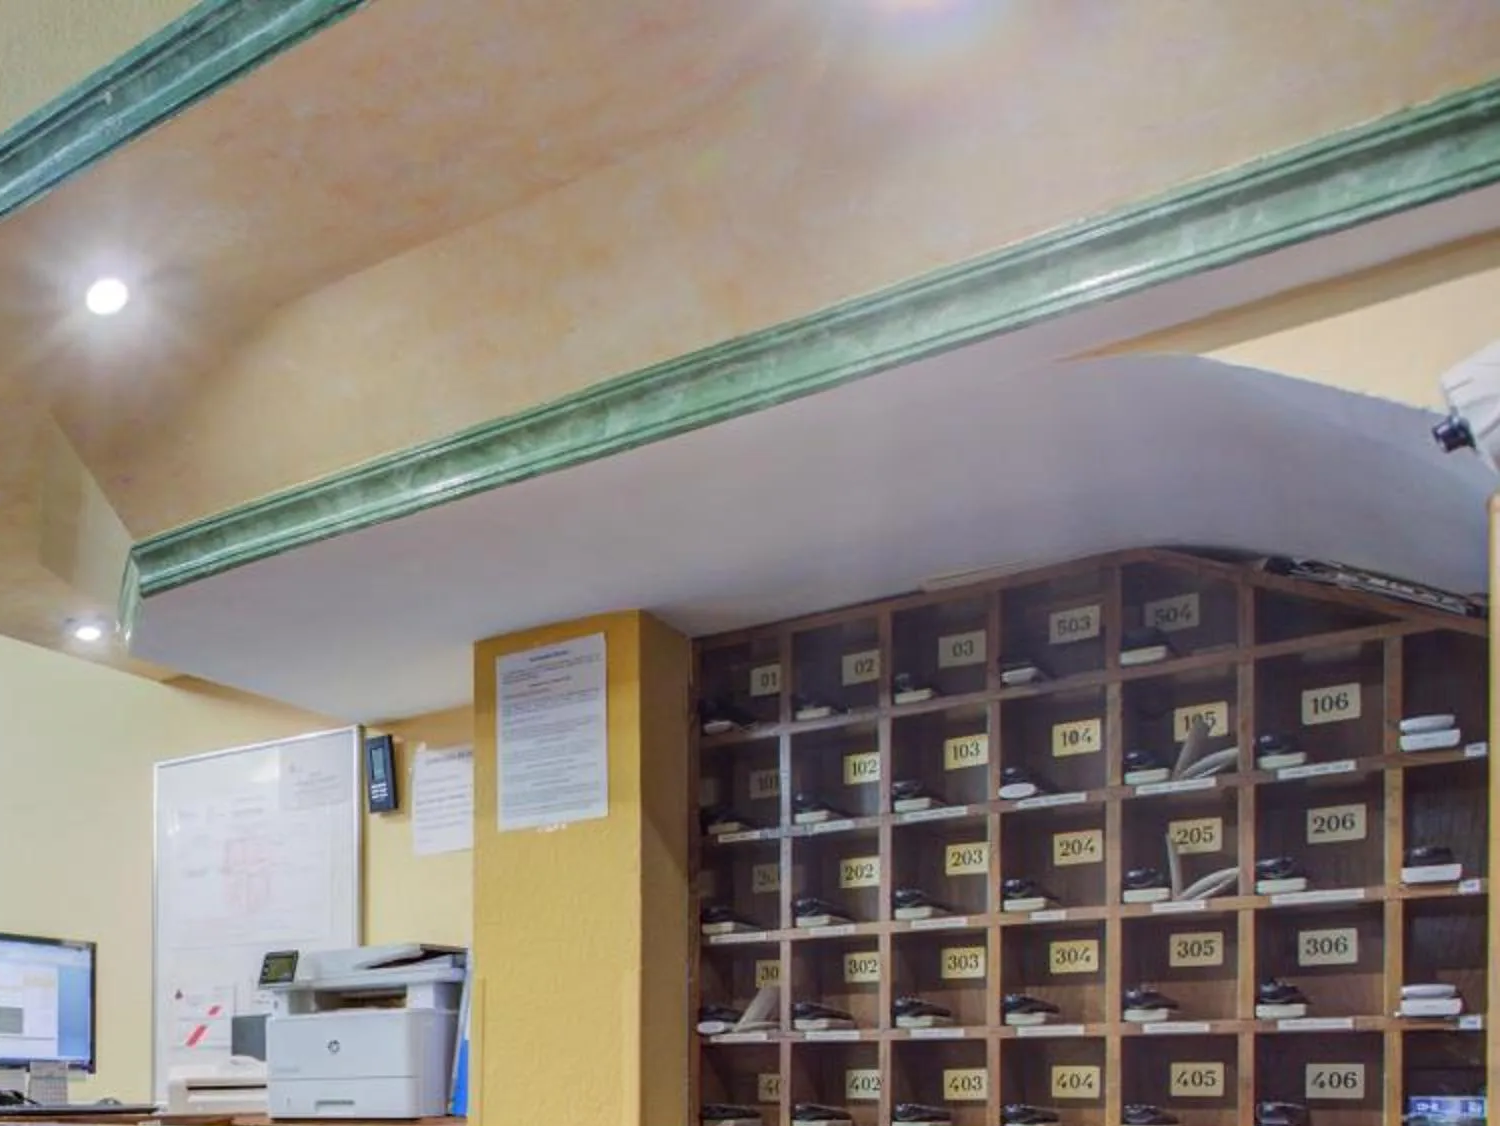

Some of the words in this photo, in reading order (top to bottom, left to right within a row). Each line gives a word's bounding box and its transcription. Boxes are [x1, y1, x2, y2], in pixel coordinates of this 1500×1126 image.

[1154, 602, 1192, 626] 504
[1056, 615, 1092, 635] 503
[951, 640, 974, 658] 03
[853, 658, 875, 674] 02
[1311, 693, 1349, 715] 106
[1060, 729, 1093, 748] 104
[952, 743, 981, 761] 103
[851, 758, 879, 777] 102
[1311, 812, 1356, 833] 206
[1176, 824, 1214, 845] 205
[1059, 838, 1096, 857] 204
[950, 849, 984, 867] 203
[844, 863, 874, 881] 202
[1175, 939, 1216, 958] 305
[1304, 936, 1349, 956] 306
[947, 953, 980, 970] 303
[1055, 947, 1092, 965] 304
[848, 958, 878, 974] 302
[848, 1075, 880, 1092] 402
[948, 1074, 983, 1092] 403
[1055, 1072, 1094, 1090] 404
[1174, 1070, 1217, 1089] 405
[1310, 1070, 1358, 1090] 406
